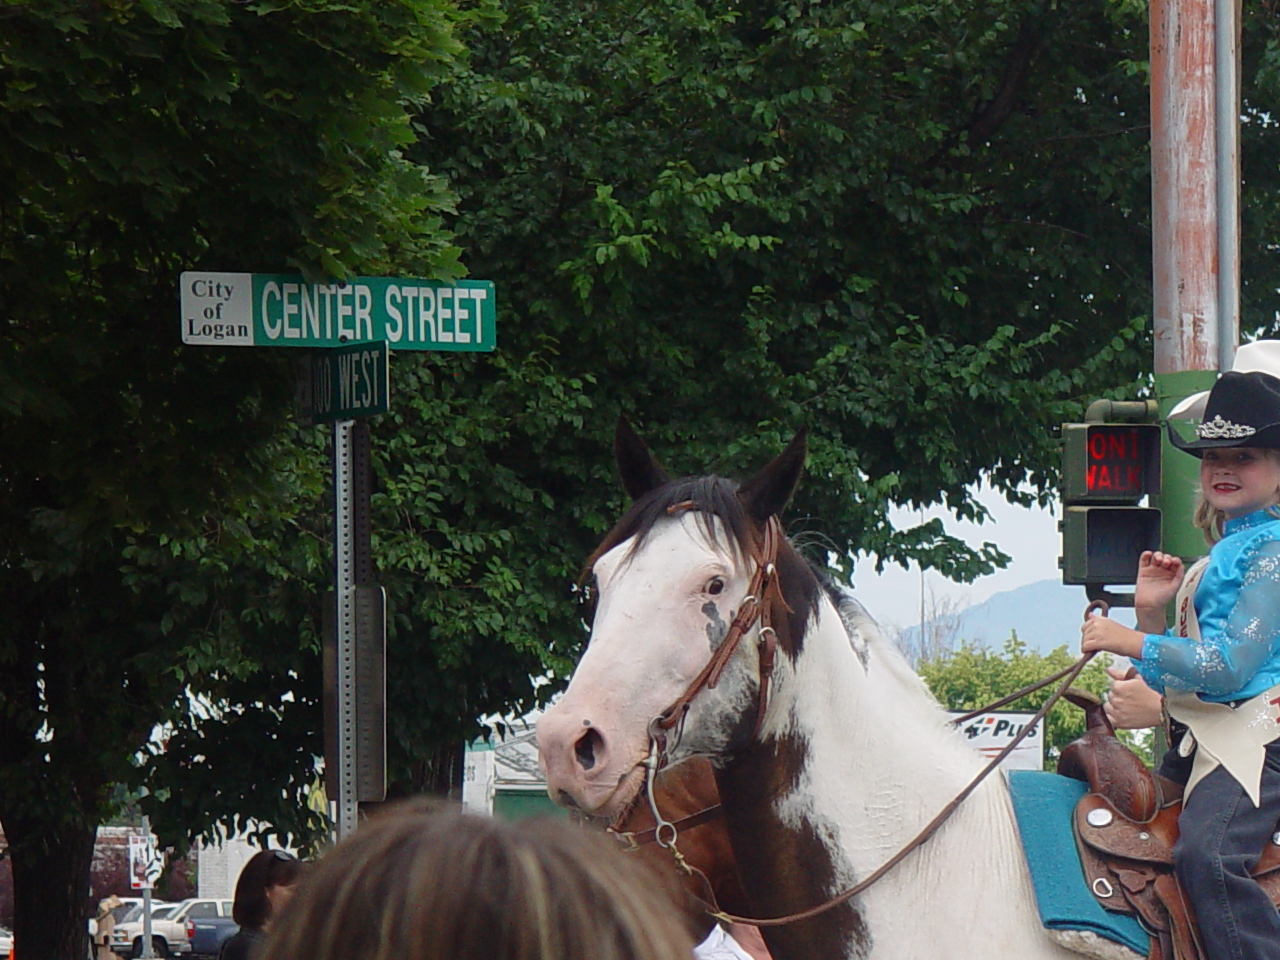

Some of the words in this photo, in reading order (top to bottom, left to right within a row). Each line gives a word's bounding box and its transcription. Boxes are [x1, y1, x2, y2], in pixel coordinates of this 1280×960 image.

[191, 279, 234, 302] City
[203, 302, 224, 320] of
[261, 280, 373, 340] CENTER
[384, 283, 487, 345] STREET
[187, 318, 249, 339] Logan
[338, 350, 379, 410] WEST
[1090, 433, 1138, 460] ONT
